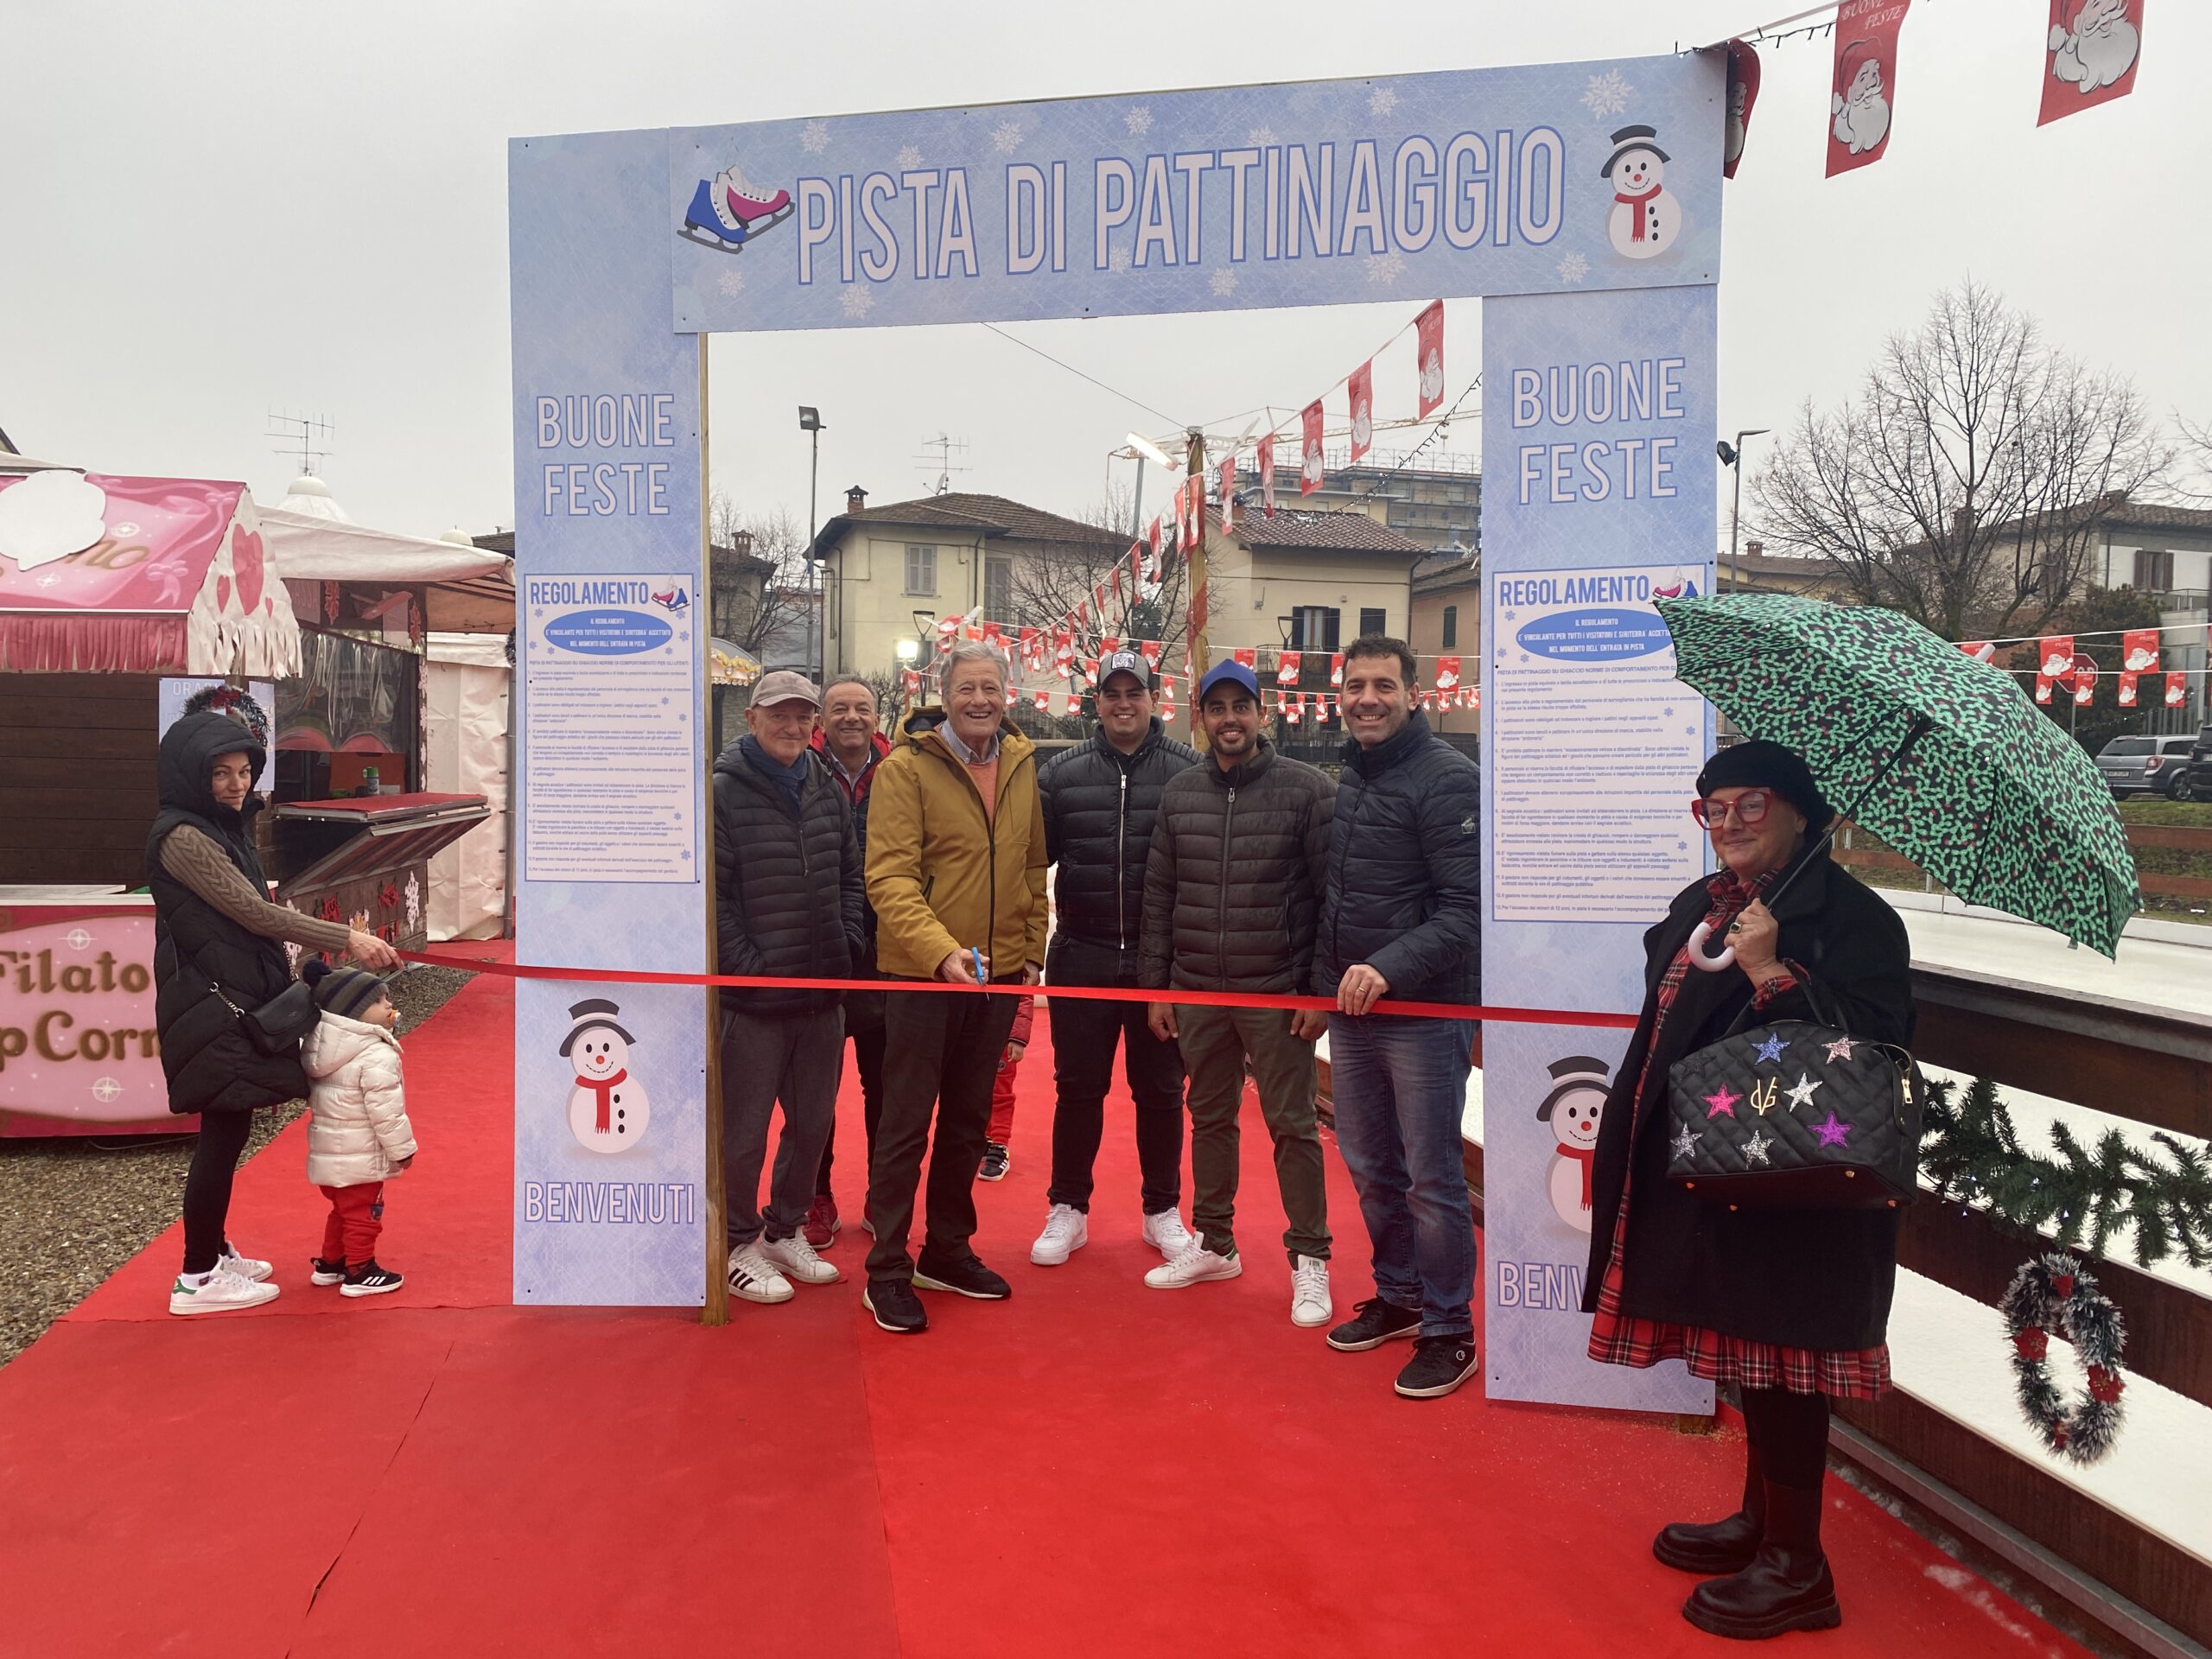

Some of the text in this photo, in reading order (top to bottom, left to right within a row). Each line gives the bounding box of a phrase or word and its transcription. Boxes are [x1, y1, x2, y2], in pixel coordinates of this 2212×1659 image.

[1866, 4, 1904, 29] FESTE
[797, 125, 1566, 285] PISTA DI PATTINAGGIO
[1512, 357, 1686, 429] BUONE
[537, 393, 675, 448] BUONE
[1519, 436, 1678, 505] FESTE
[543, 462, 670, 517] FESTE
[530, 582, 648, 605] REGOLAMENTO
[1499, 575, 1649, 607] REGOLAMENTO
[1568, 632, 1582, 640] TUTTI
[1586, 631, 1613, 639] VISITATORI
[1649, 629, 1671, 638] ACCETTA
[1581, 618, 1618, 626] REGOLAMENTO
[1560, 645, 1586, 653] MOMENTO
[524, 1181, 695, 1224] BENVENUTI
